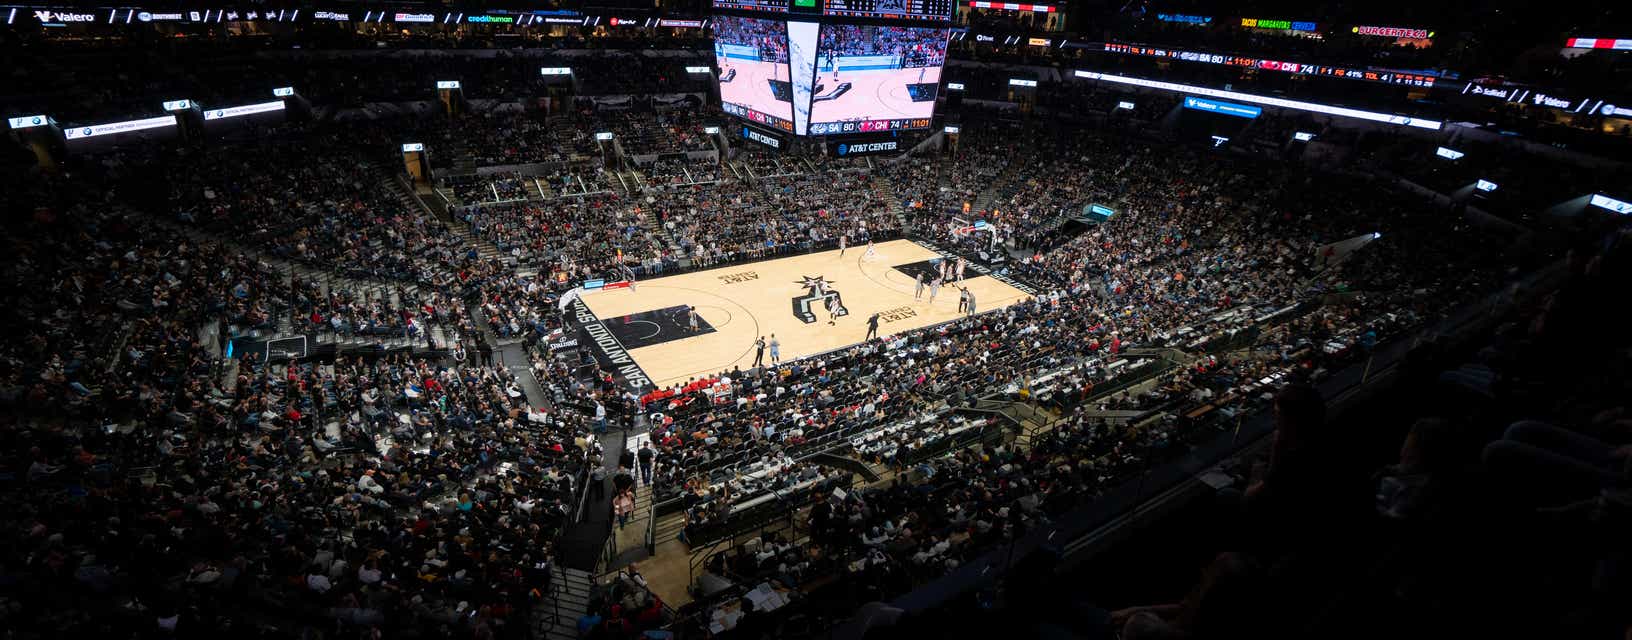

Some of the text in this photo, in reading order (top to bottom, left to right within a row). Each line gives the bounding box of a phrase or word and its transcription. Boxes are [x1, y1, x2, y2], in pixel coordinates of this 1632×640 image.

[54, 12, 94, 22] Valero
[468, 15, 513, 23] credithuman
[1241, 18, 1256, 27] TACOS
[1257, 19, 1291, 29] MARGARITAS
[1358, 26, 1427, 38] BURGERTECA
[1211, 55, 1223, 64] 80
[1234, 57, 1254, 66] 11:01
[1281, 62, 1297, 72] CHI
[1301, 64, 1314, 74] 74
[1346, 70, 1362, 78] 41%
[1365, 72, 1378, 80] TOL
[1545, 97, 1570, 108] Valero
[828, 124, 839, 132] SA
[843, 123, 854, 131] 80
[874, 121, 888, 130] CHI
[890, 120, 900, 129] 74
[912, 119, 929, 128] 11:01
[749, 130, 779, 148] AT&T CENTER
[849, 142, 897, 153] AT&T CENTER
[882, 310, 917, 323] AT&T
[585, 323, 632, 364] ANTONIO
[618, 363, 651, 388] SAN
